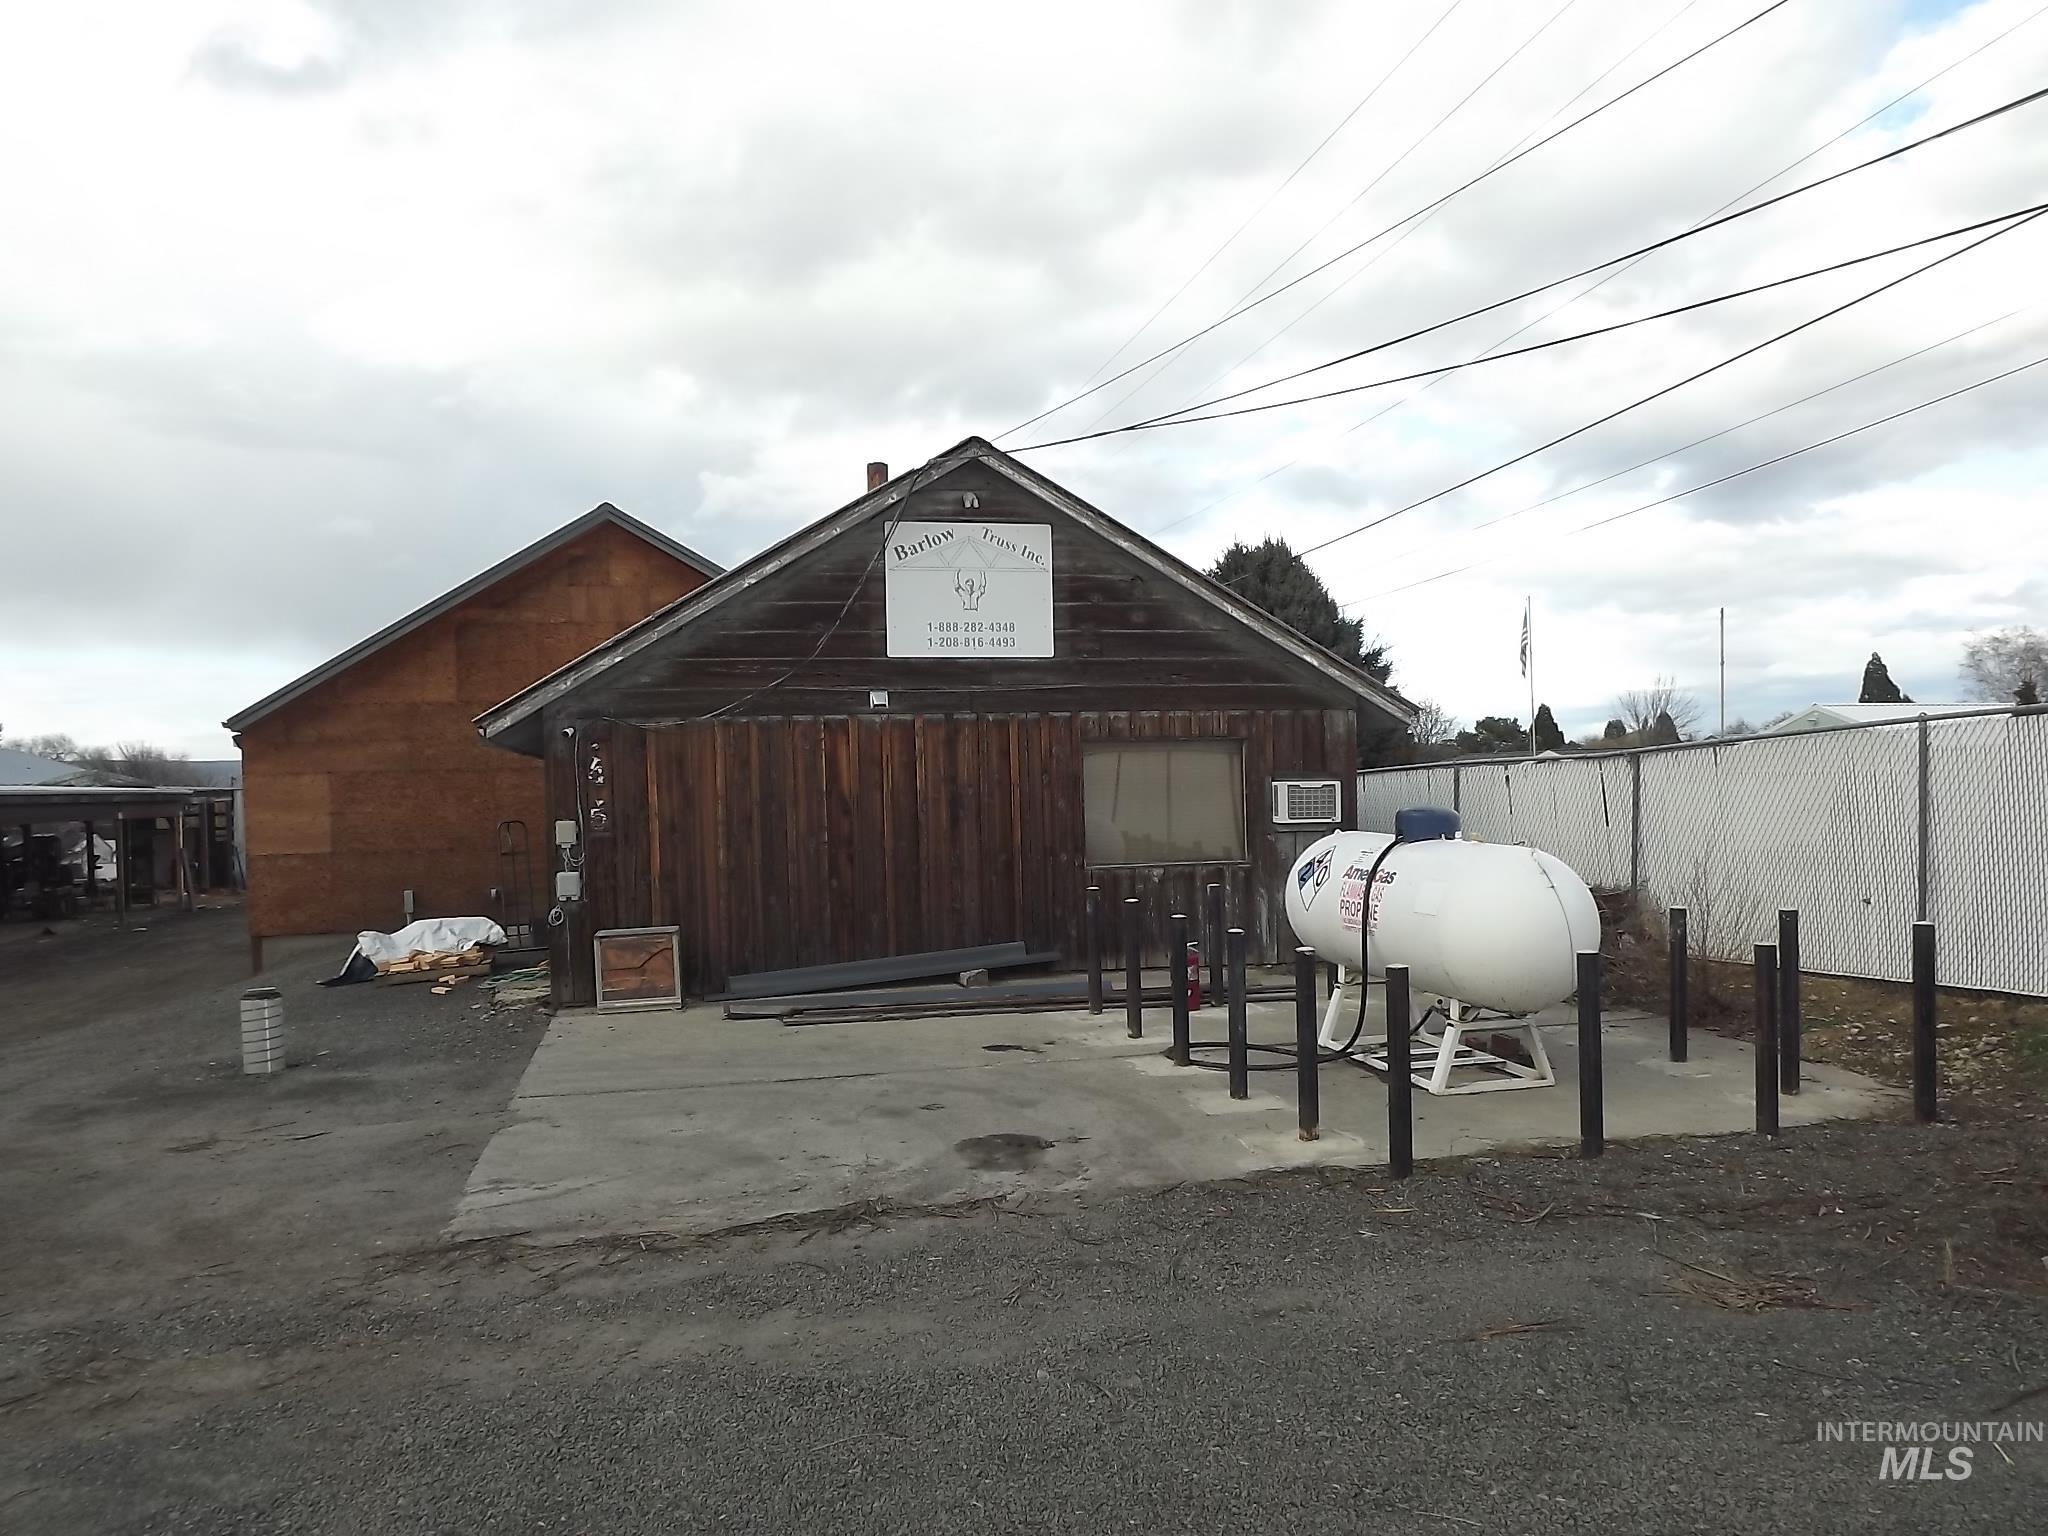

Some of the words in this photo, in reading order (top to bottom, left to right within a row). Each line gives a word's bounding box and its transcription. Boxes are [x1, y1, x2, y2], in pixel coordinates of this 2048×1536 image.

[893, 528, 956, 561] Barlow
[982, 527, 1018, 553] Truss
[1020, 545, 1045, 566] Inc.
[928, 622, 1015, 633] 1-888-282-4348
[928, 637, 1016, 648] 1-208-816-4493
[1316, 850, 1332, 868] 4
[1300, 861, 1313, 881] 2
[1316, 865, 1329, 887] 0
[1343, 865, 1397, 884] AmeGas
